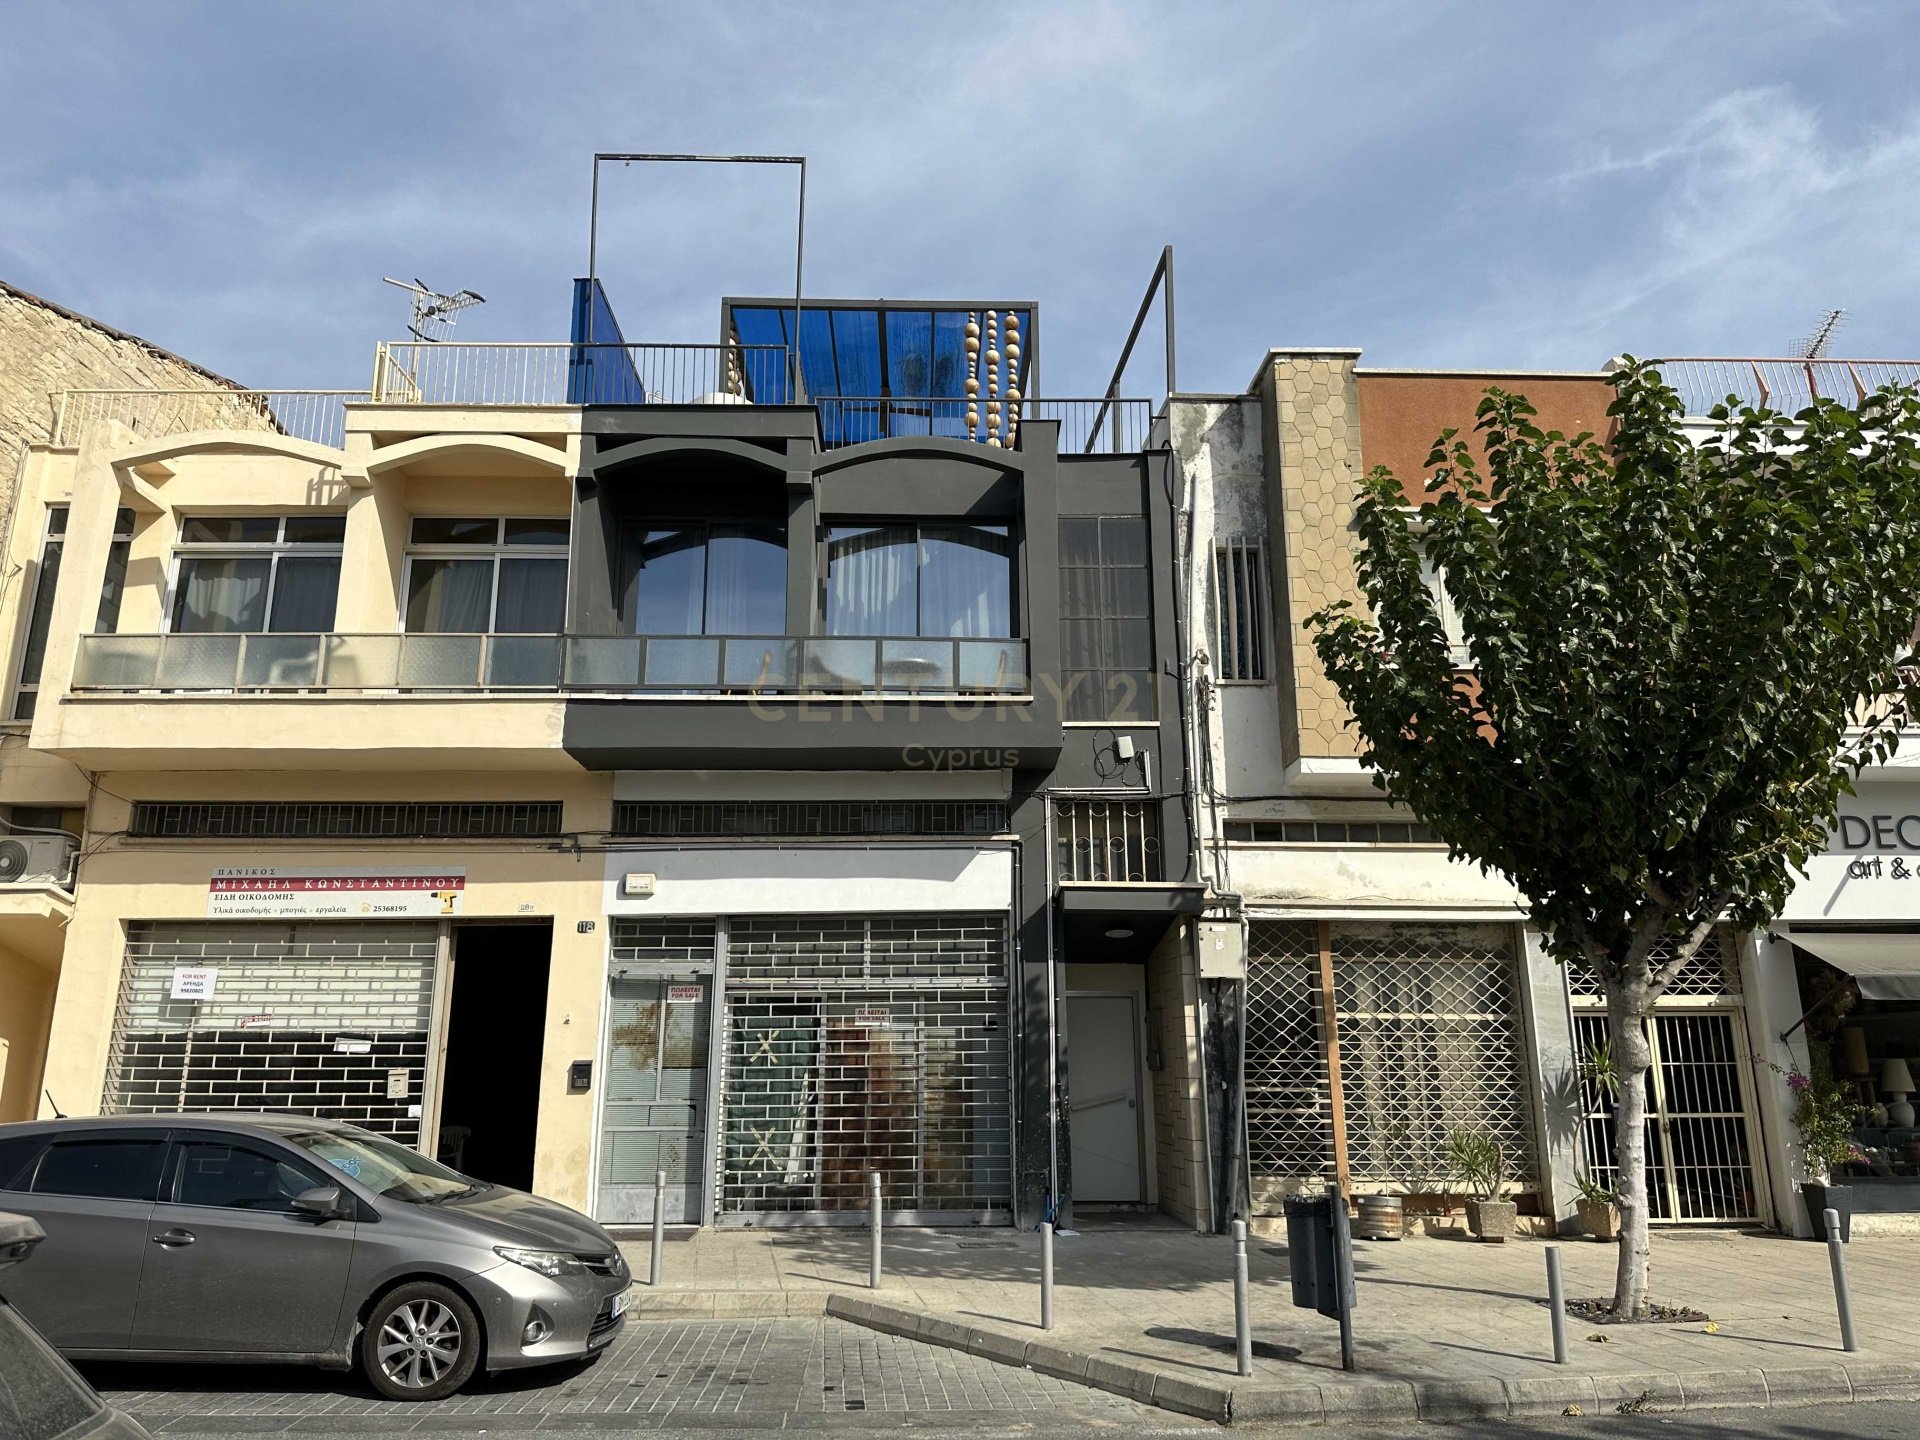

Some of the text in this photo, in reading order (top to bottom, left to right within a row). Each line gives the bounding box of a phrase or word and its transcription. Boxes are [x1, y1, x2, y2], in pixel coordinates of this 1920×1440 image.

[217, 868, 276, 876] ΠΑΝΙΚΟΣ
[1849, 856, 1883, 877] art
[1893, 857, 1912, 878] &
[215, 878, 460, 889] ΜΙΧΑΗΛ ΚΩΝΣΤΑΝΤΙΝΟΥ
[214, 893, 295, 901] ΕΙΔΗ ΟΙΚΟΔΟΜΗΣ
[213, 906, 347, 915] Υλικά οικοδομής μπογιές εργαλεία
[577, 921, 594, 933] 118
